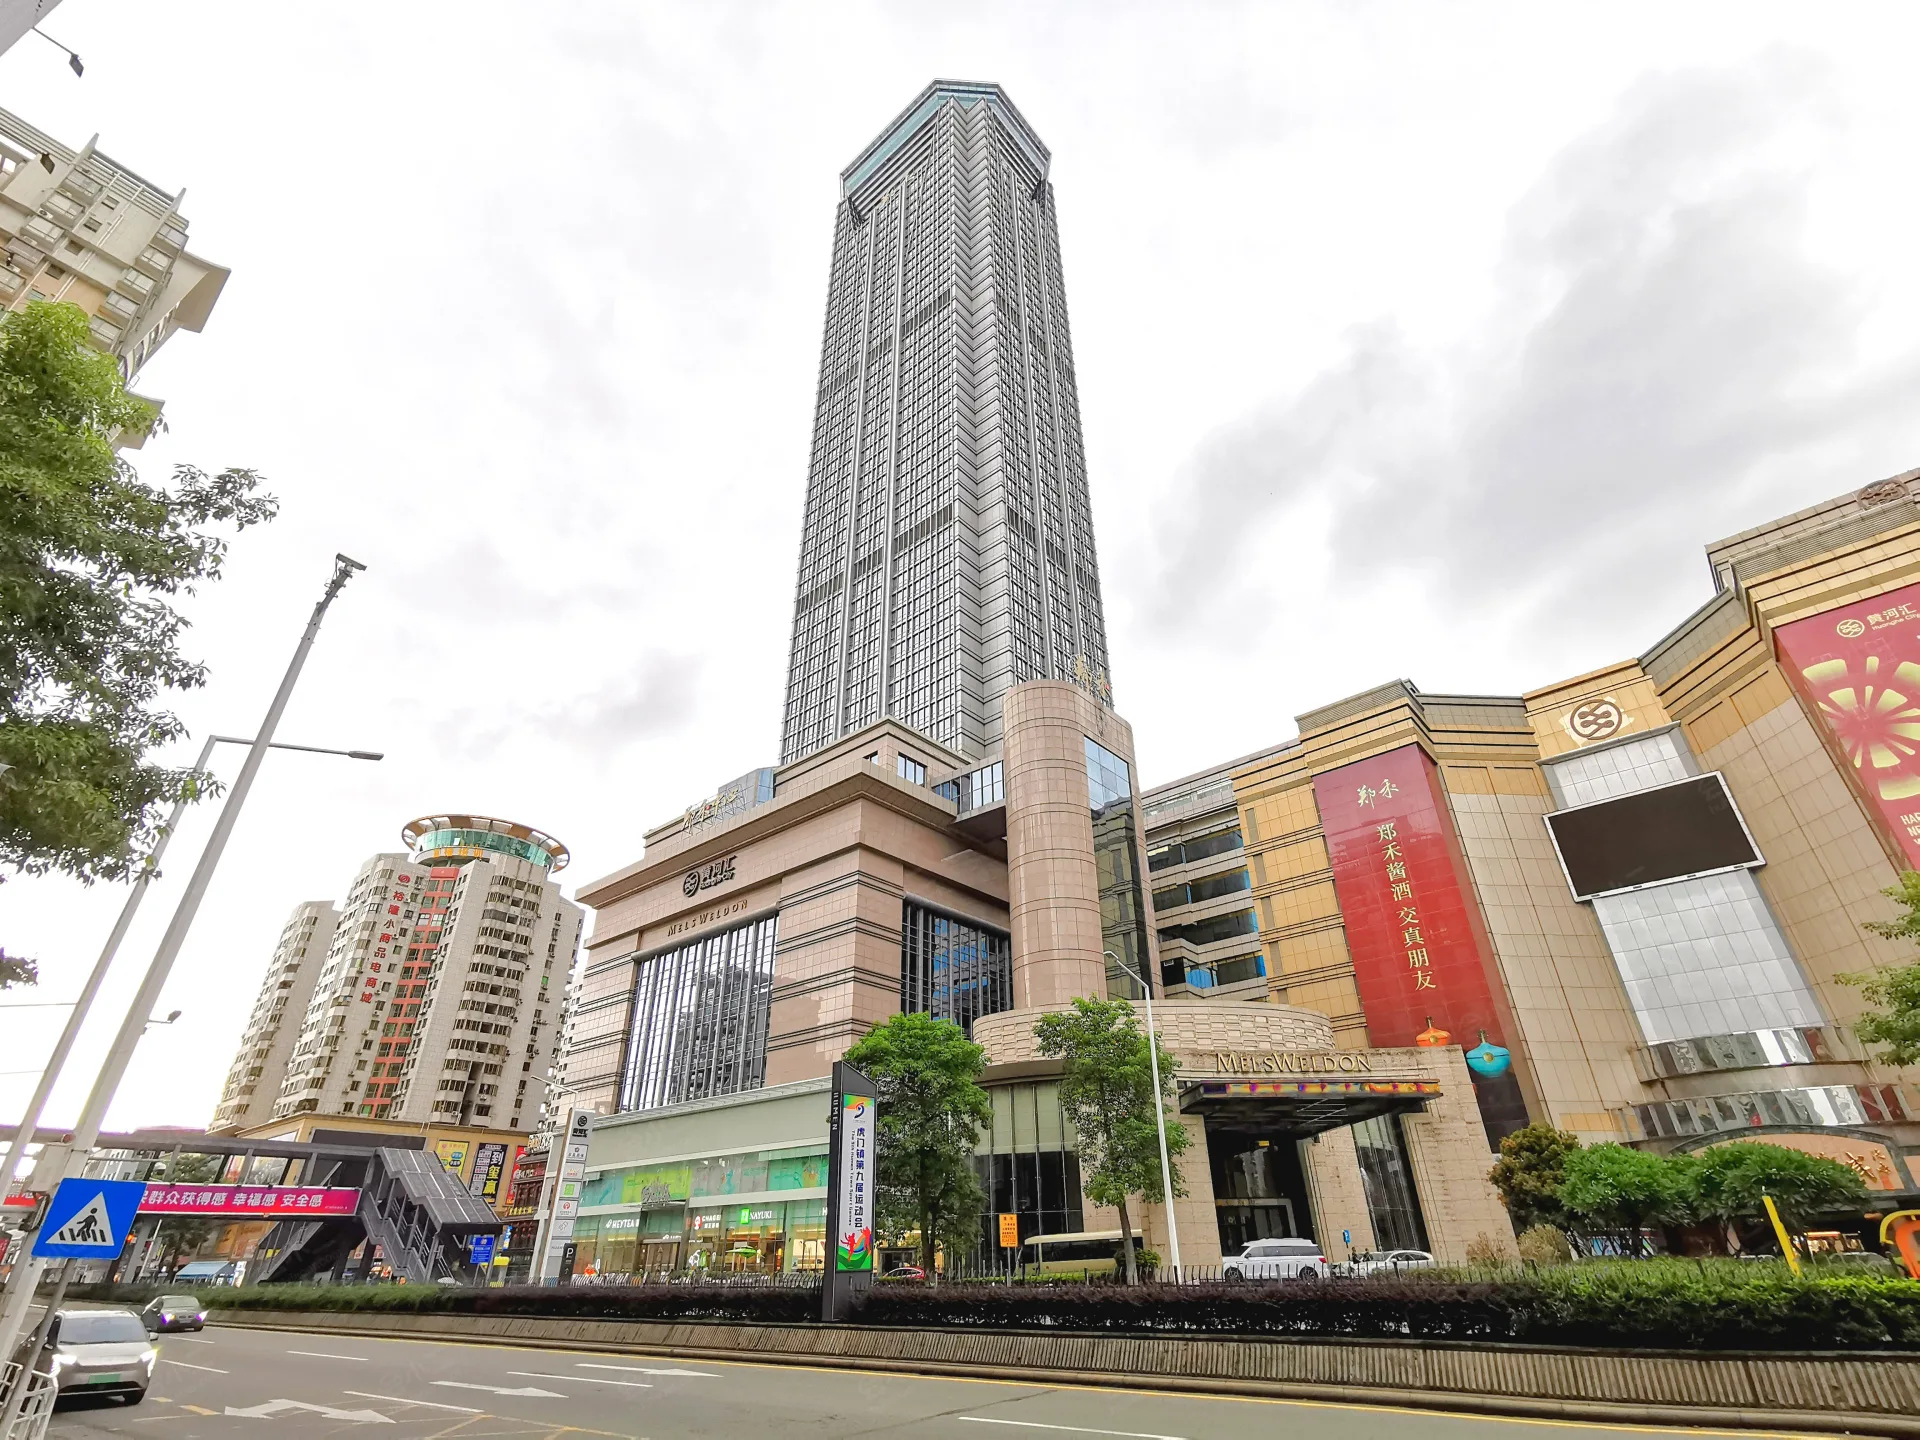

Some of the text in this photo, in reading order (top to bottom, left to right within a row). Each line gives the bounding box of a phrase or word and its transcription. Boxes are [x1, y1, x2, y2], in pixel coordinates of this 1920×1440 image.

[1867, 602, 1917, 626] 黄河汇
[1376, 822, 1437, 991] 郑禾酱酒 交真朋友
[855, 1127, 866, 1228] 虎门镇第九届运动会
[232, 1193, 276, 1206] 幸福感
[280, 1194, 324, 1207] 安全感
[750, 1210, 772, 1220] NAYUKI
[612, 1219, 637, 1229] HEYTEA
[566, 1247, 574, 1259] P
